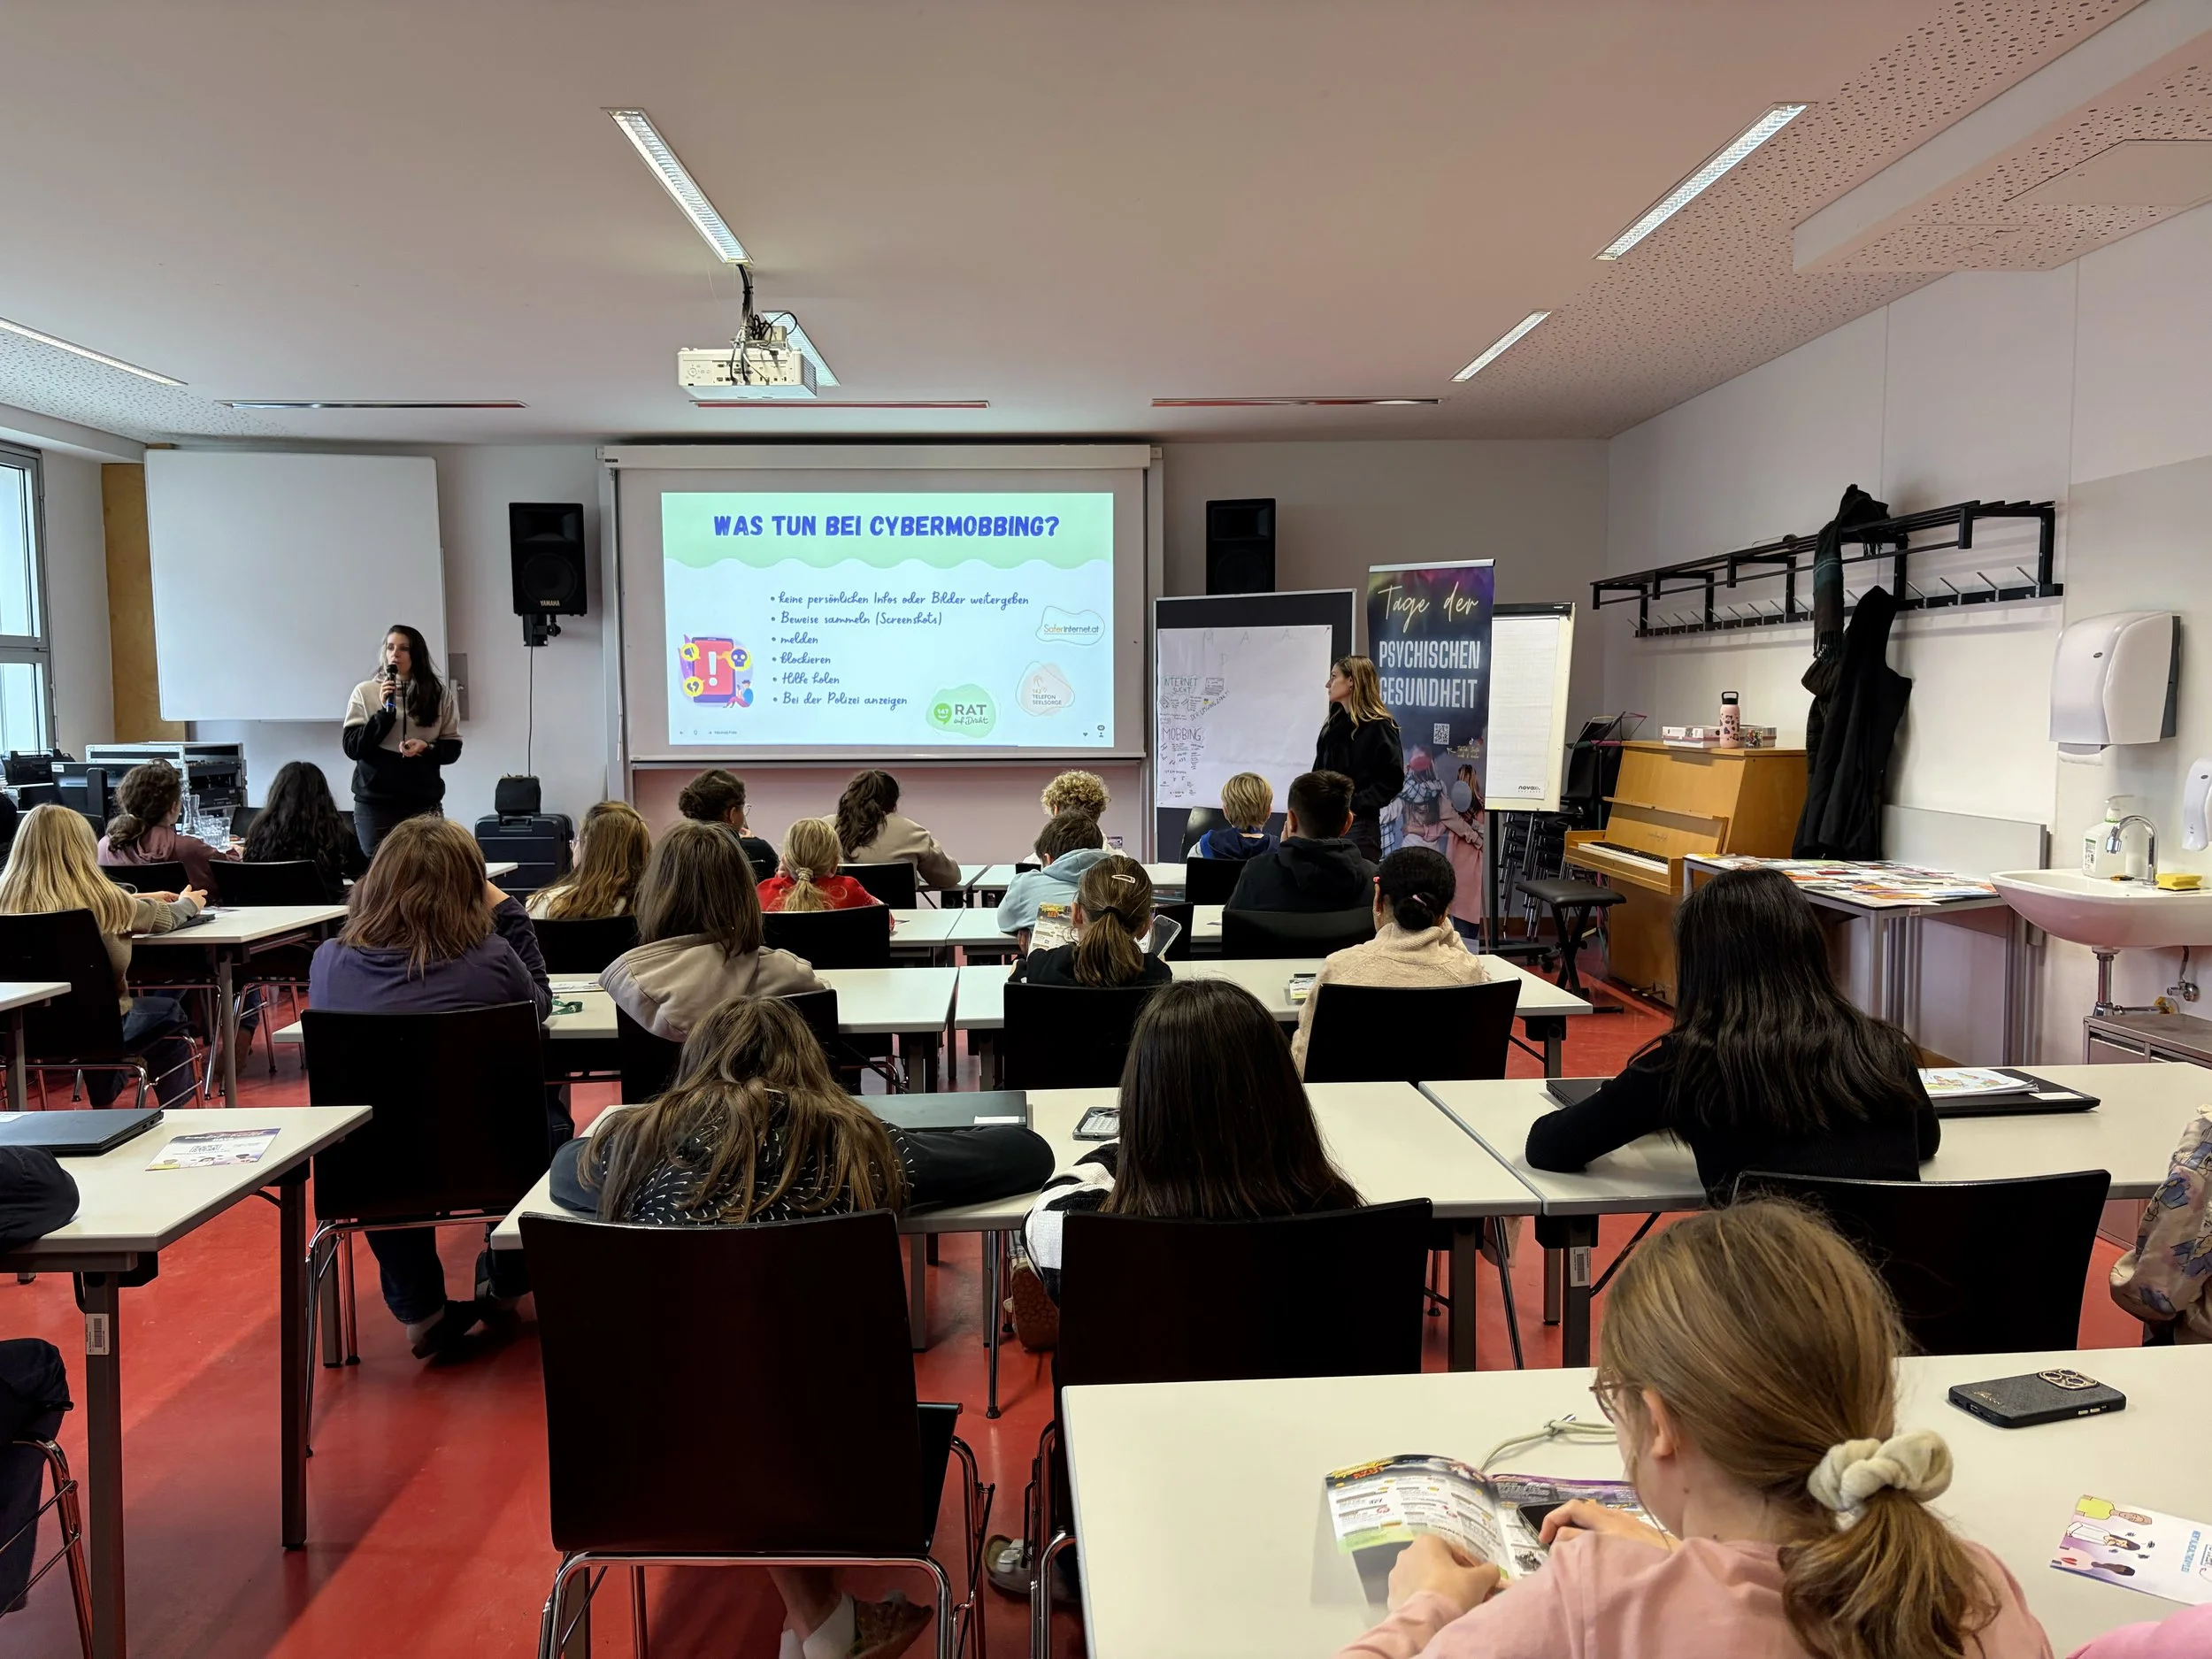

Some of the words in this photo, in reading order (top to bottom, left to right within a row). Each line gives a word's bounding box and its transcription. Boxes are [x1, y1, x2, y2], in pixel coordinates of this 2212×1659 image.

[714, 516, 763, 536] WAS
[772, 516, 816, 536] TUN
[826, 516, 861, 536] BEI
[870, 516, 1059, 536] CYBERMOBBING?
[779, 591, 803, 603] keine
[808, 591, 868, 609] persönlichen
[874, 591, 897, 604] Infos
[902, 591, 926, 604] oder
[932, 591, 965, 604] Bilder
[971, 592, 1029, 611] weitergeben
[1378, 585, 1430, 633] Tage
[1444, 581, 1479, 622] der
[780, 611, 818, 624] Beweise
[825, 611, 870, 624] sammeln
[876, 611, 942, 626] (Screenshots)
[780, 632, 818, 644] melden
[780, 652, 831, 664] blockieren
[1379, 641, 1480, 669] PSYCHISCHEN
[782, 672, 808, 684] Hilfe
[812, 672, 840, 684] holen
[783, 691, 799, 704] Bei
[803, 692, 822, 704] der
[828, 691, 859, 704] Polizei
[864, 697, 907, 710] anzeigen
[1379, 677, 1478, 709] GESUNDHEIT
[955, 703, 987, 715] RAT
[1162, 727, 1202, 741] MOBBING
